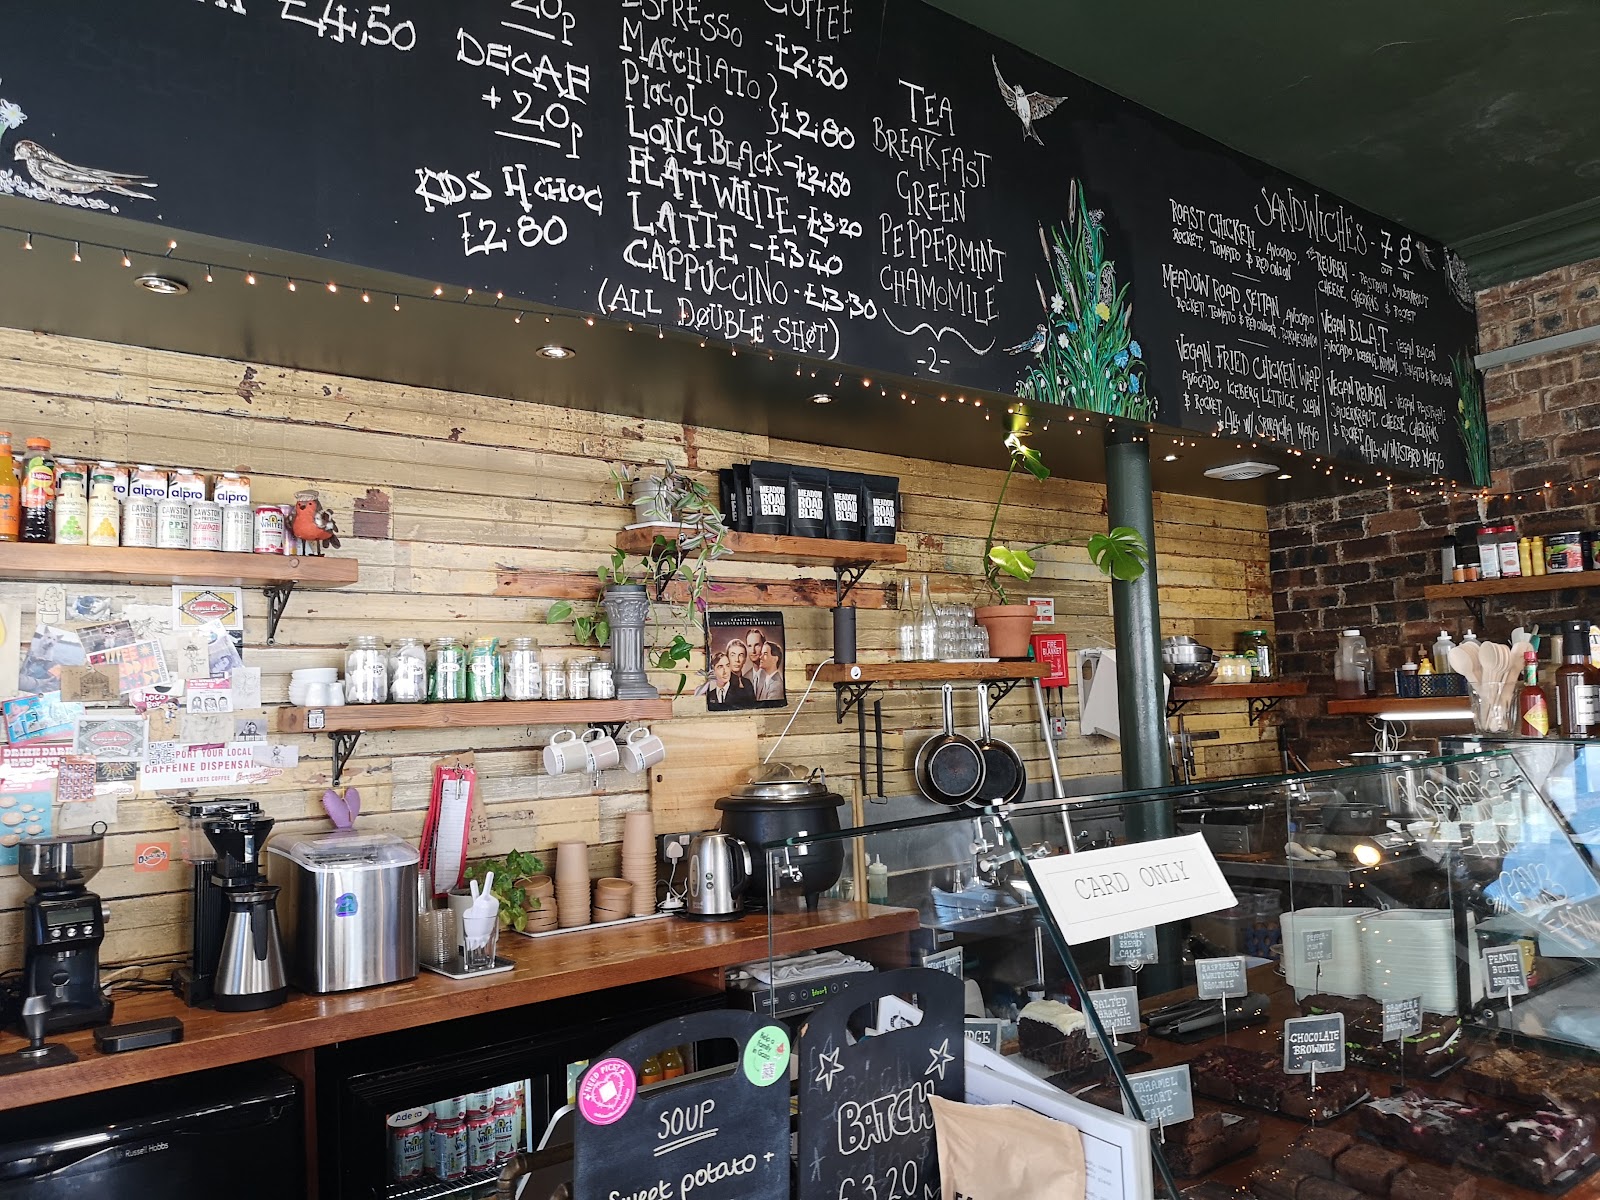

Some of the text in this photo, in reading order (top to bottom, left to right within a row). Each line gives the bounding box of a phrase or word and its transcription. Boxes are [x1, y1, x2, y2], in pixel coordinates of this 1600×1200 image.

[621, 0, 743, 47] SPRESSO
[456, 28, 591, 104] DECAF
[619, 17, 761, 99] MACCHIATO
[622, 58, 724, 127] PICCOLO
[899, 78, 956, 136] TEA
[511, 90, 584, 159] 20p
[625, 104, 707, 165] LONG
[708, 129, 783, 178] BLACK
[872, 116, 992, 188] BREAKFAST
[414, 166, 492, 212] KIDS
[627, 145, 706, 209] FLAT
[710, 174, 797, 235] WHITE
[896, 170, 966, 223] GREEN
[1169, 198, 1205, 231] ROAST
[1254, 186, 1367, 256] SANDWICHES
[627, 191, 738, 265] LATTE
[879, 212, 1007, 282] PEPPERMINT
[623, 237, 788, 306] CAPPUCCINO
[1210, 240, 1241, 263] TOMATO
[1255, 255, 1269, 274] RED
[1270, 261, 1291, 281] ONION
[1315, 251, 1348, 283] REUBEN
[880, 264, 999, 326] CHAMOMILE
[1162, 263, 1210, 299] MEADOW
[1212, 278, 1241, 311] ROAD
[1208, 304, 1236, 325] TOMATO
[1320, 309, 1346, 341] VEGAN
[1416, 343, 1436, 364] BACON
[1176, 334, 1321, 392] VEGAN FRIED CHICKEN WRAP
[1227, 380, 1261, 408] ICEBERG
[1303, 395, 1321, 417] SLAW
[1326, 370, 1353, 404] VEGAN
[1354, 380, 1387, 410] REUBEN
[1194, 394, 1223, 416] ROCKET
[1297, 422, 1320, 450] MAYO
[1340, 425, 1364, 445] ROCKET
[1422, 448, 1445, 475] MAYO
[132, 484, 165, 499] alpro
[171, 487, 203, 500] alpro
[217, 490, 248, 503] alpro
[759, 485, 786, 494] MEADOW
[760, 493, 786, 506] ROAD
[798, 488, 823, 498] MEADOW
[833, 492, 857, 502] MEADOW
[761, 504, 786, 517] BLEND
[798, 497, 823, 509] ROAD
[798, 507, 824, 520] BLEND
[834, 501, 858, 513] ROAD
[872, 498, 894, 507] MEADOW
[873, 506, 895, 517] ROAD
[835, 510, 858, 523] BLEND
[873, 516, 896, 528] BLEND
[1042, 647, 1062, 655] BLANKET
[202, 748, 252, 757] YOUR LOCAL
[144, 762, 195, 774] CAFFEINE
[1074, 860, 1190, 899] CARD ONLY
[1119, 949, 1142, 958] CAKE
[1488, 952, 1518, 965] PEANUT
[1491, 963, 1520, 974] BUTTER
[1093, 997, 1127, 1009] SALTED
[1098, 1007, 1130, 1018] ARAMEL
[1289, 1030, 1340, 1042] CHOCOLATE
[1293, 1043, 1336, 1055] BROWNIE
[1133, 1076, 1178, 1093] CARAMEL
[657, 1099, 715, 1140] SOUP
[838, 1080, 935, 1155] BATCH
[1143, 1105, 1174, 1121] CAKE
[125, 1141, 169, 1158] Russell Hobbs
[680, 1153, 757, 1200] potato
